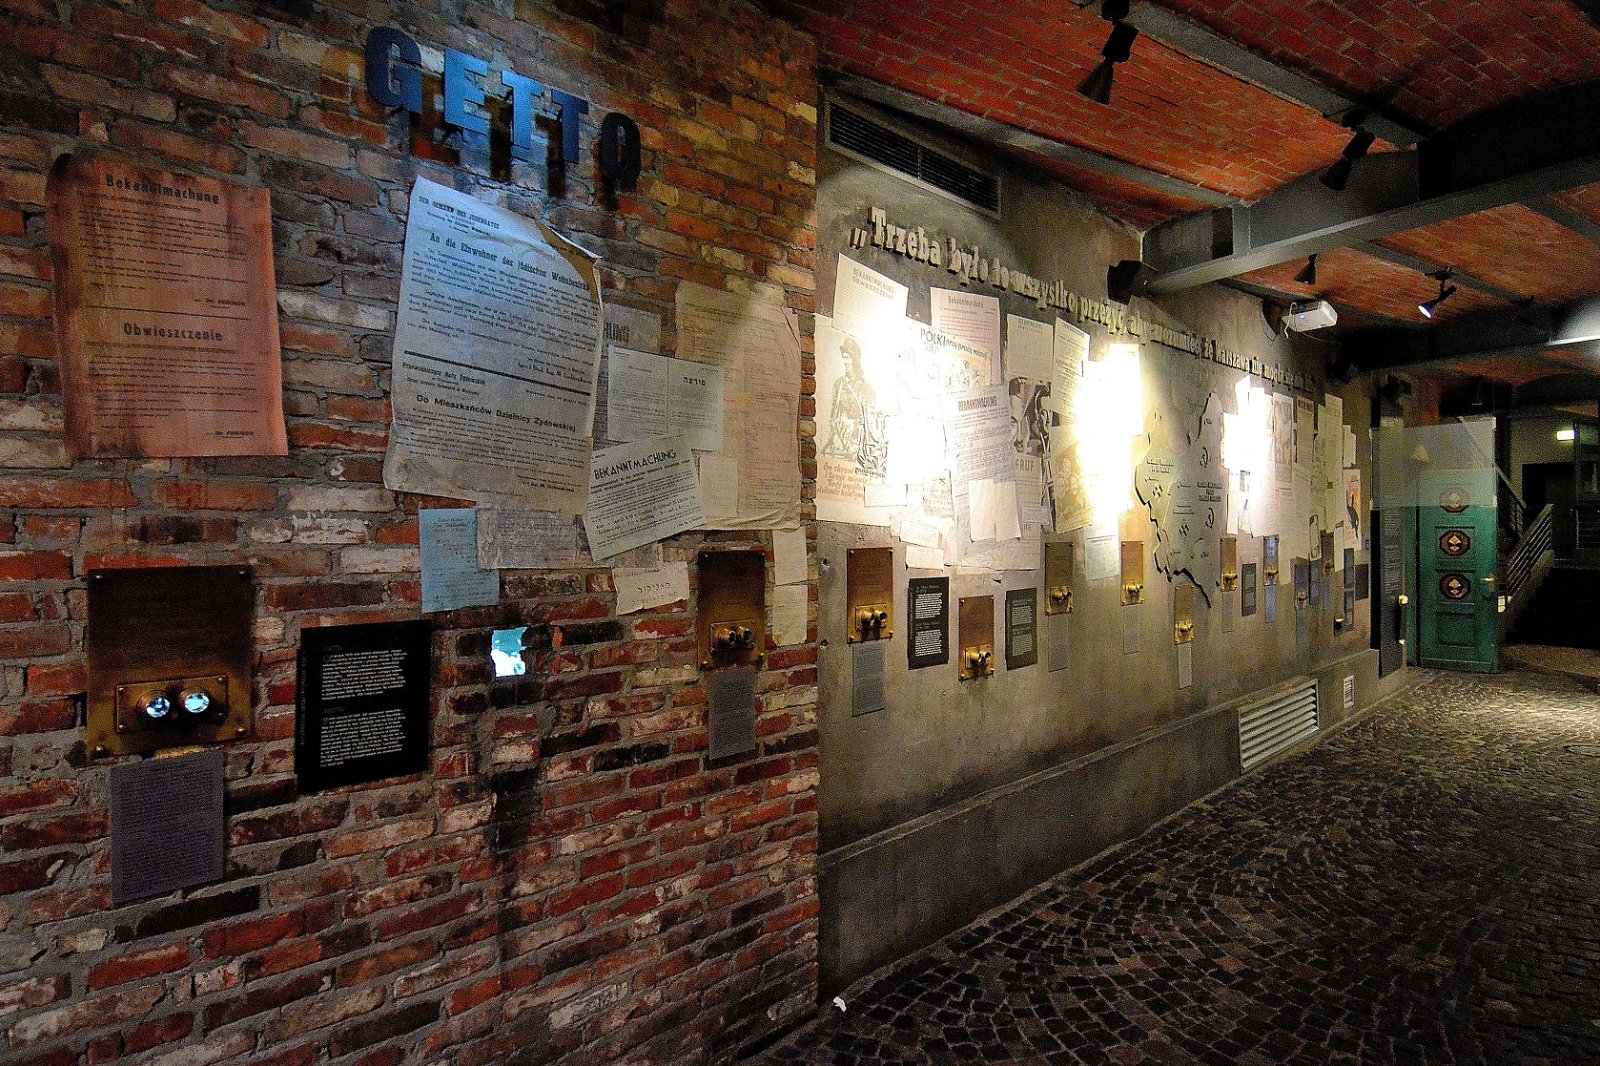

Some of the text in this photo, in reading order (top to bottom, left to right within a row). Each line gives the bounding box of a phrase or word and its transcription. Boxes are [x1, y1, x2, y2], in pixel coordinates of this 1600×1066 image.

[365, 26, 641, 193] GETTO
[430, 232, 440, 243] An
[445, 238, 456, 249] die
[948, 237, 989, 288] było
[123, 322, 224, 342] Obwieszczenie
[416, 394, 429, 404] Do
[434, 398, 491, 415] Mieszkańców
[496, 410, 532, 424] Dzielnicy
[593, 449, 677, 480] BEKANNTMACHUNG
